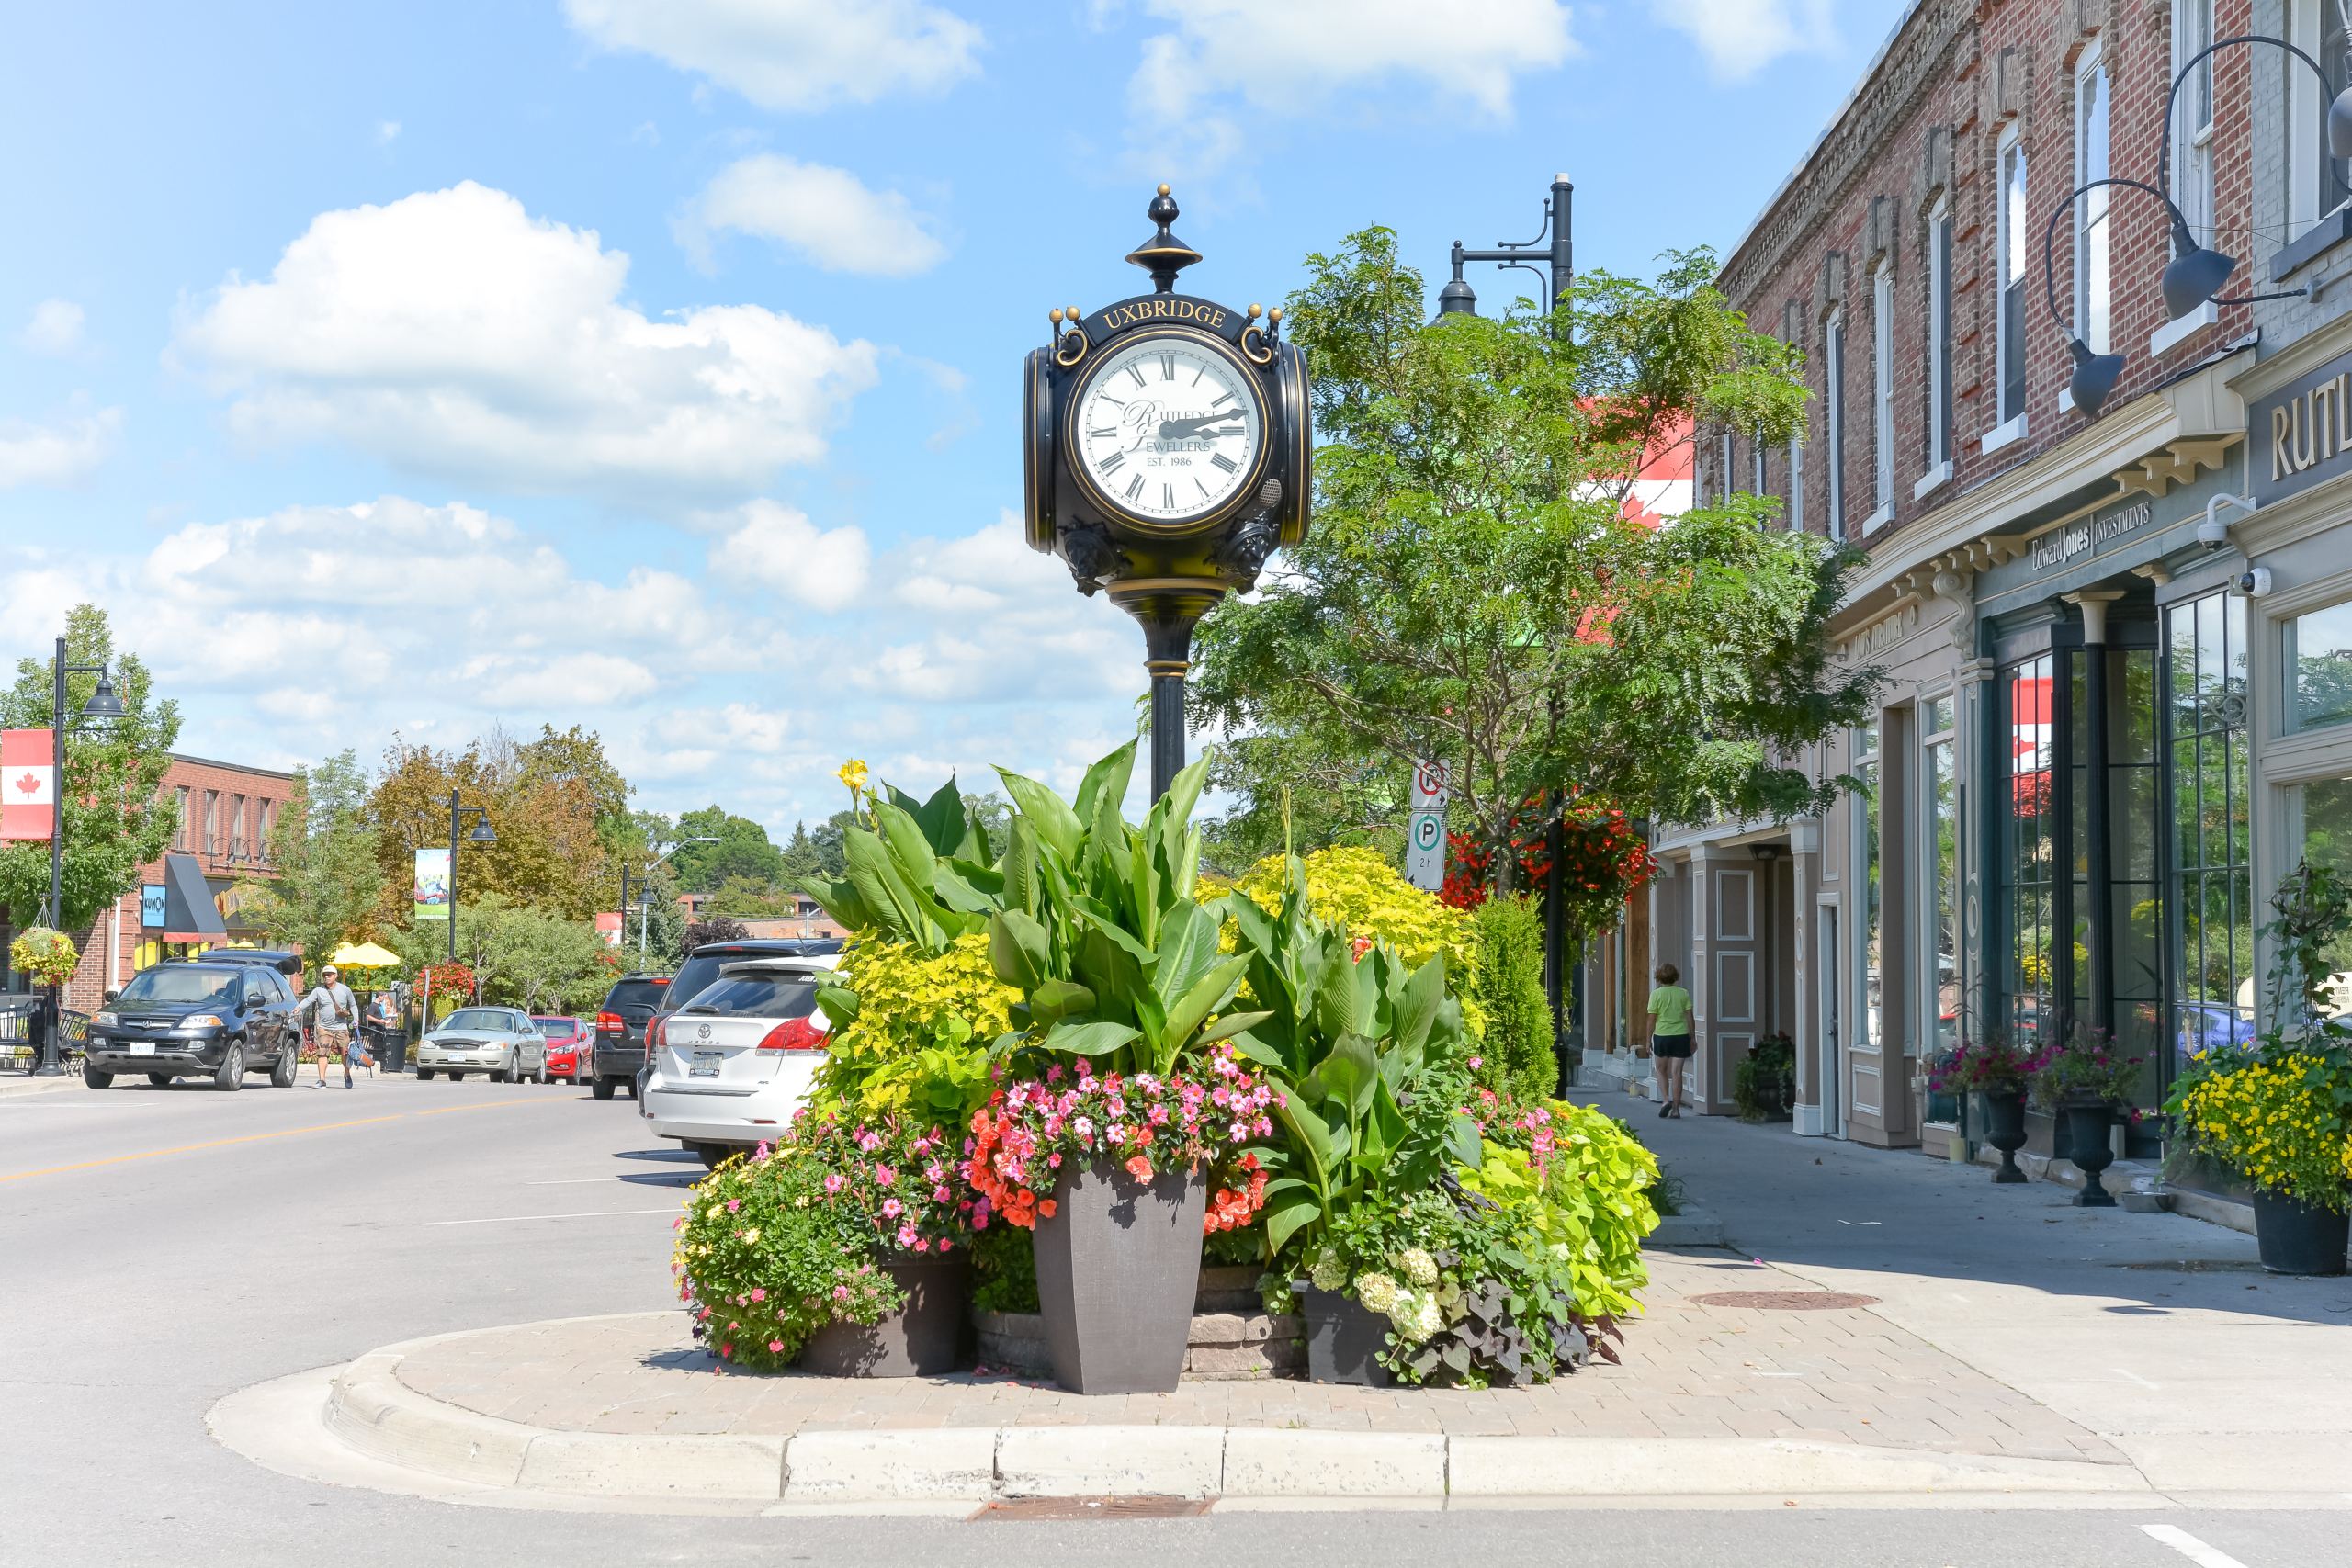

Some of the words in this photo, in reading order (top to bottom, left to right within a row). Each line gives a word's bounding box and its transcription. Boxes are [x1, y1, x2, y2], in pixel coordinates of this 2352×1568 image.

[1102, 299, 1227, 329] UXBRIDGE
[1147, 457, 1166, 467] EST.
[1170, 457, 1193, 467] 1986
[2094, 501, 2149, 545] INVESTMENTS
[1422, 823, 1434, 841] P
[1419, 858, 1424, 868] 2
[1426, 858, 1431, 868] h
[144, 897, 165, 911] KUMON
